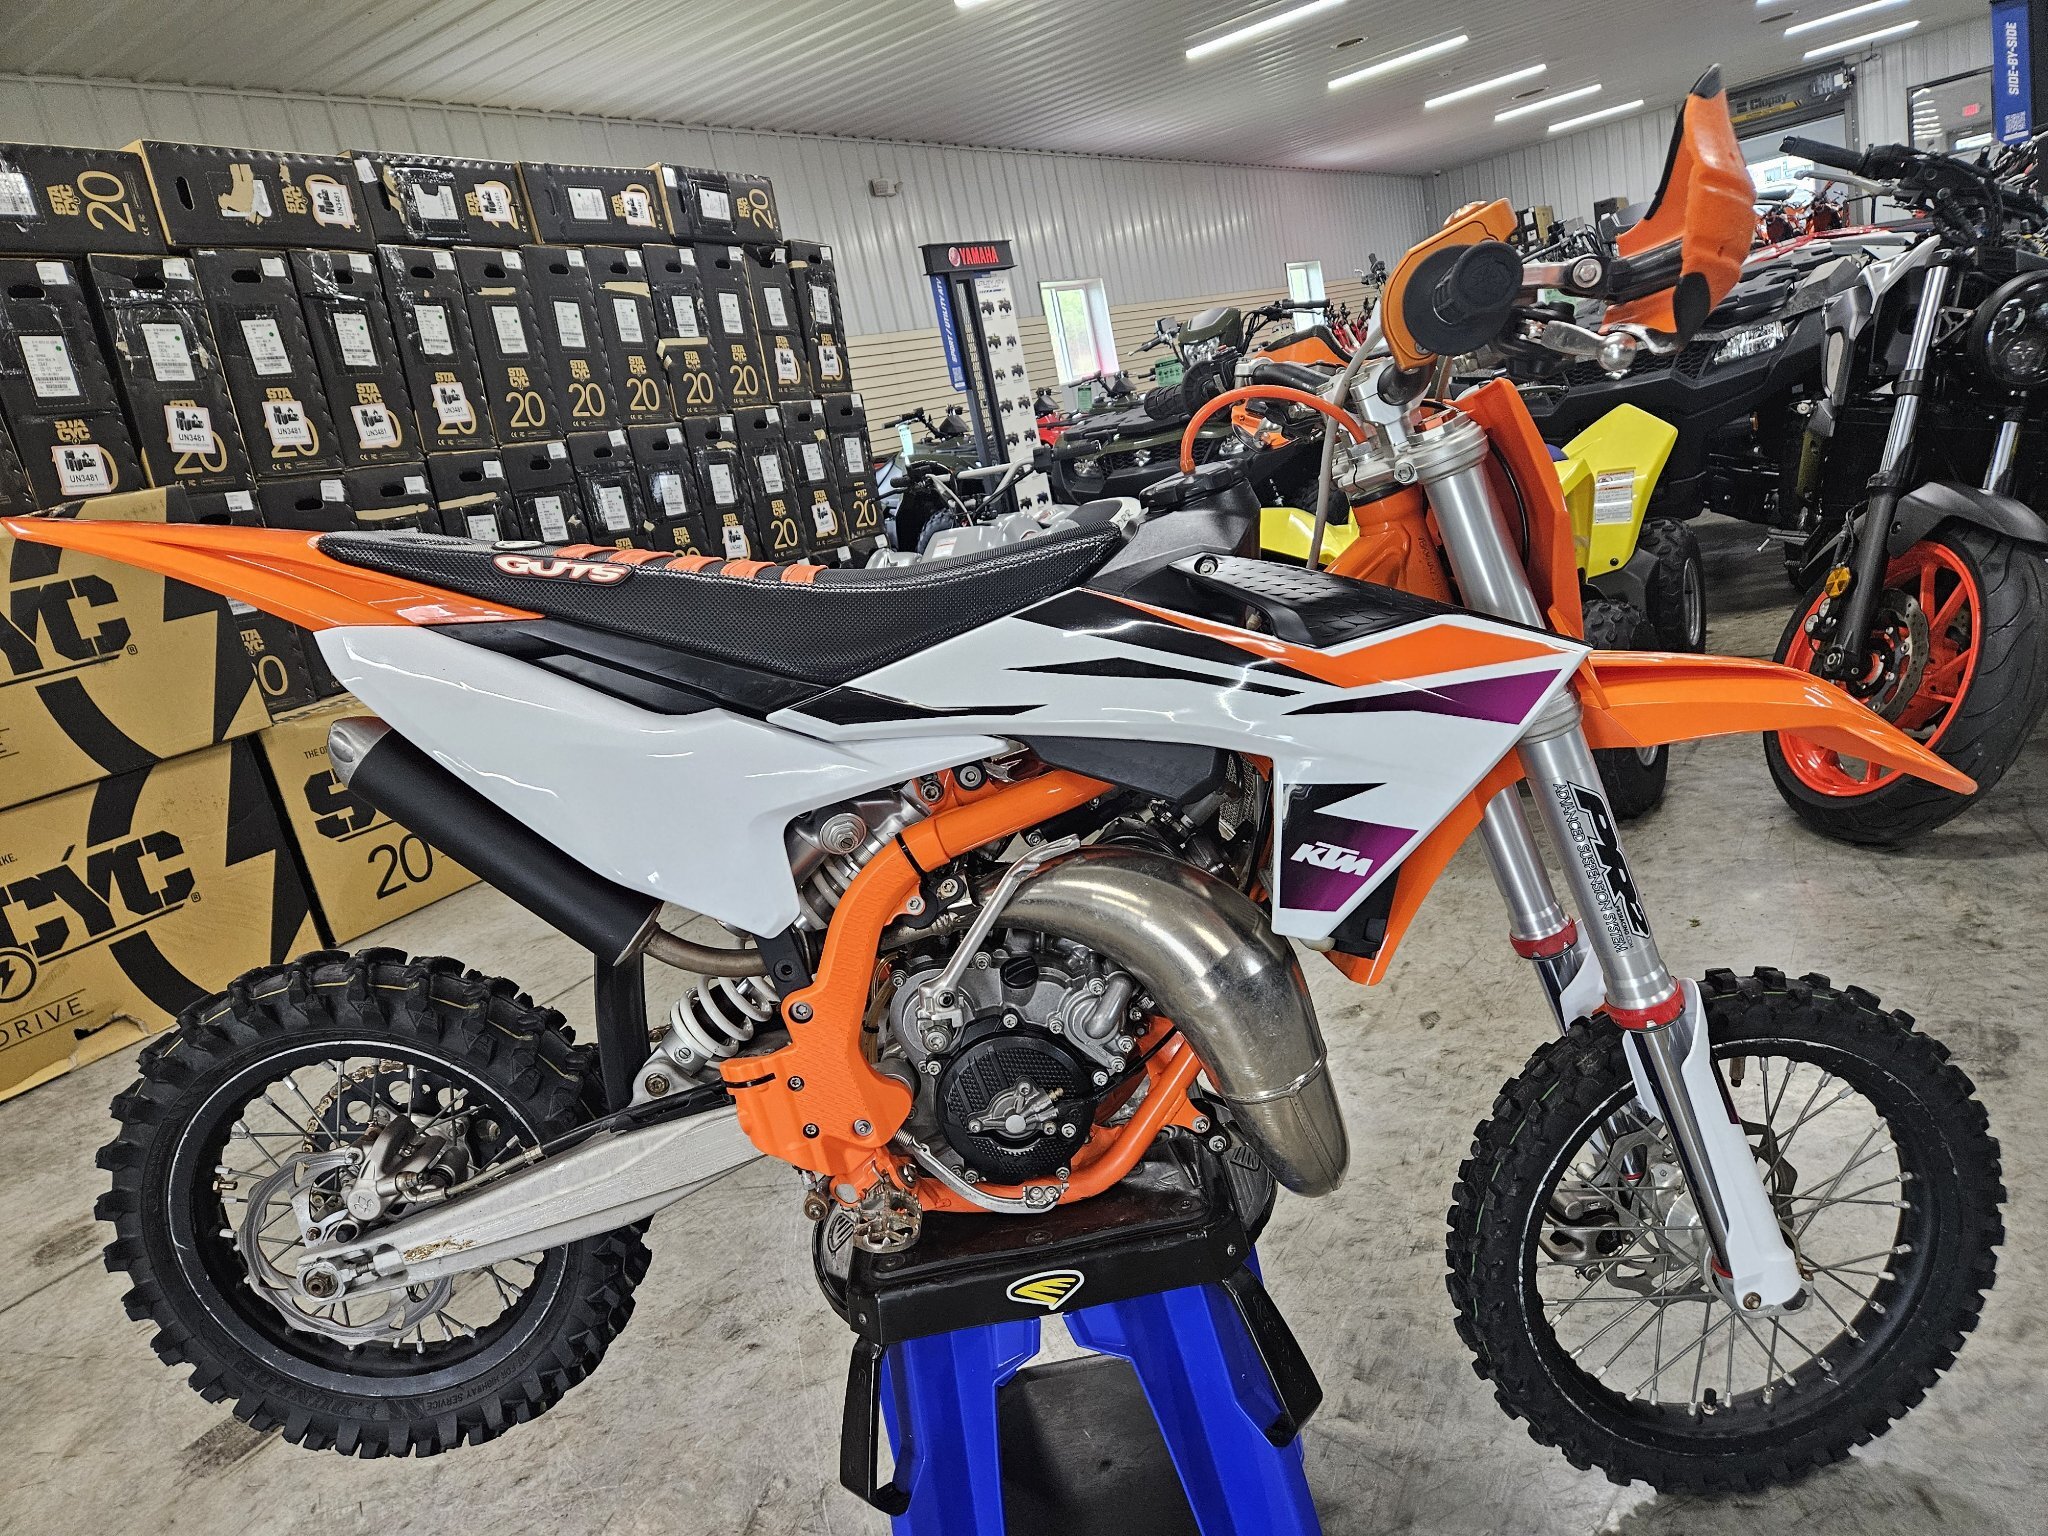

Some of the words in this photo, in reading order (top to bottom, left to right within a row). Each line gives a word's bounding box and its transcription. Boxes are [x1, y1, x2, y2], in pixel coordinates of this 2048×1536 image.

[2005, 21, 2020, 96] SIDE-BY-SIDE
[76, 170, 137, 233] 20
[748, 188, 774, 230] 20
[959, 246, 999, 265] YAMAHA
[936, 277, 944, 297] ATV
[939, 295, 951, 329] UTILITY
[948, 334, 958, 363] SPORT
[266, 387, 292, 399] STA
[355, 382, 379, 394] STA
[626, 378, 660, 410] 20
[683, 372, 714, 404] 20
[730, 365, 759, 395] 20
[506, 391, 546, 427] 20
[568, 383, 606, 416] 20
[179, 433, 205, 442] UN3481
[69, 474, 99, 483] UN3481
[853, 500, 877, 528] 20
[771, 518, 798, 549] 20
[493, 554, 630, 584] GUTS
[303, 748, 319, 760] THE
[368, 834, 433, 900] 20
[1290, 841, 1374, 877] KTM
[1552, 783, 1586, 843] ADVANCED
[1577, 843, 1613, 912] SUSPENSION
[1602, 912, 1629, 954] SYSTEM
[1566, 781, 1650, 939] PR2
[426, 1393, 464, 1411] SERVICE
